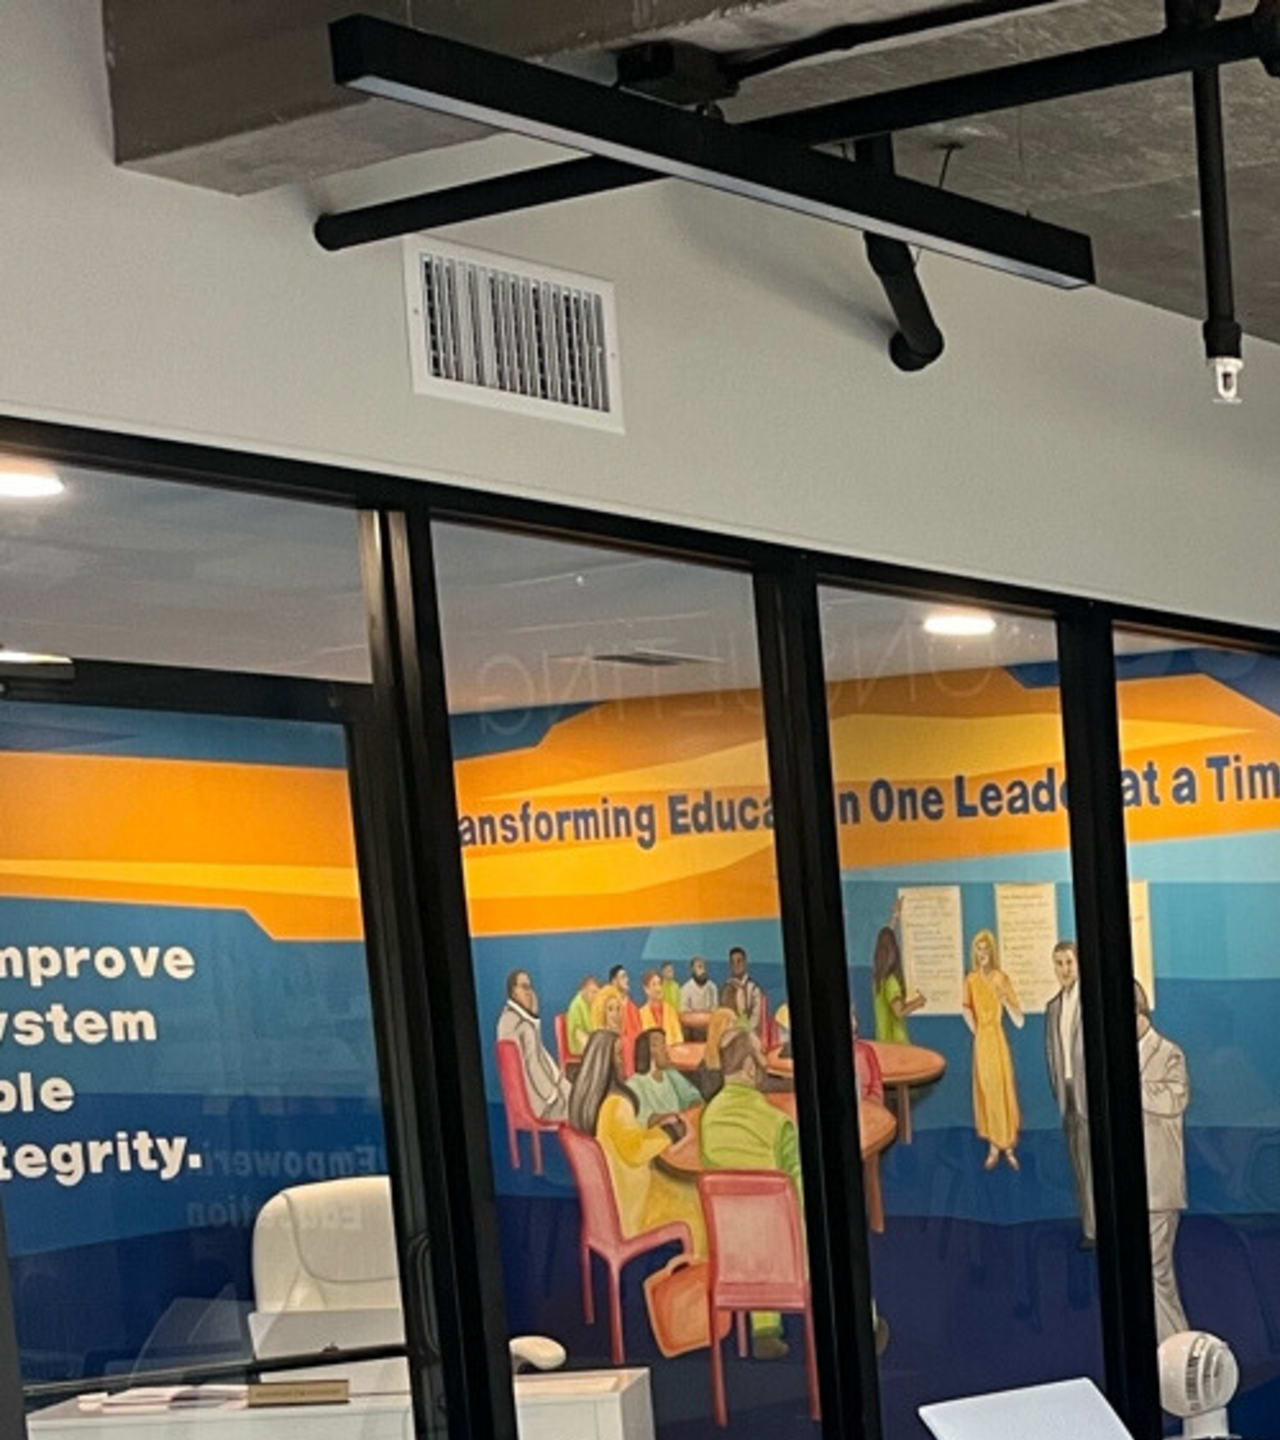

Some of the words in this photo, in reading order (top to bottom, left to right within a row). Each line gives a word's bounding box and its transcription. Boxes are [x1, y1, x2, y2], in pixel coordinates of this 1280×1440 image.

[457, 798, 656, 850] ansforming
[869, 777, 944, 822] One
[954, 767, 1068, 818] Lead
[1121, 761, 1160, 806] at
[1172, 767, 1197, 804] a
